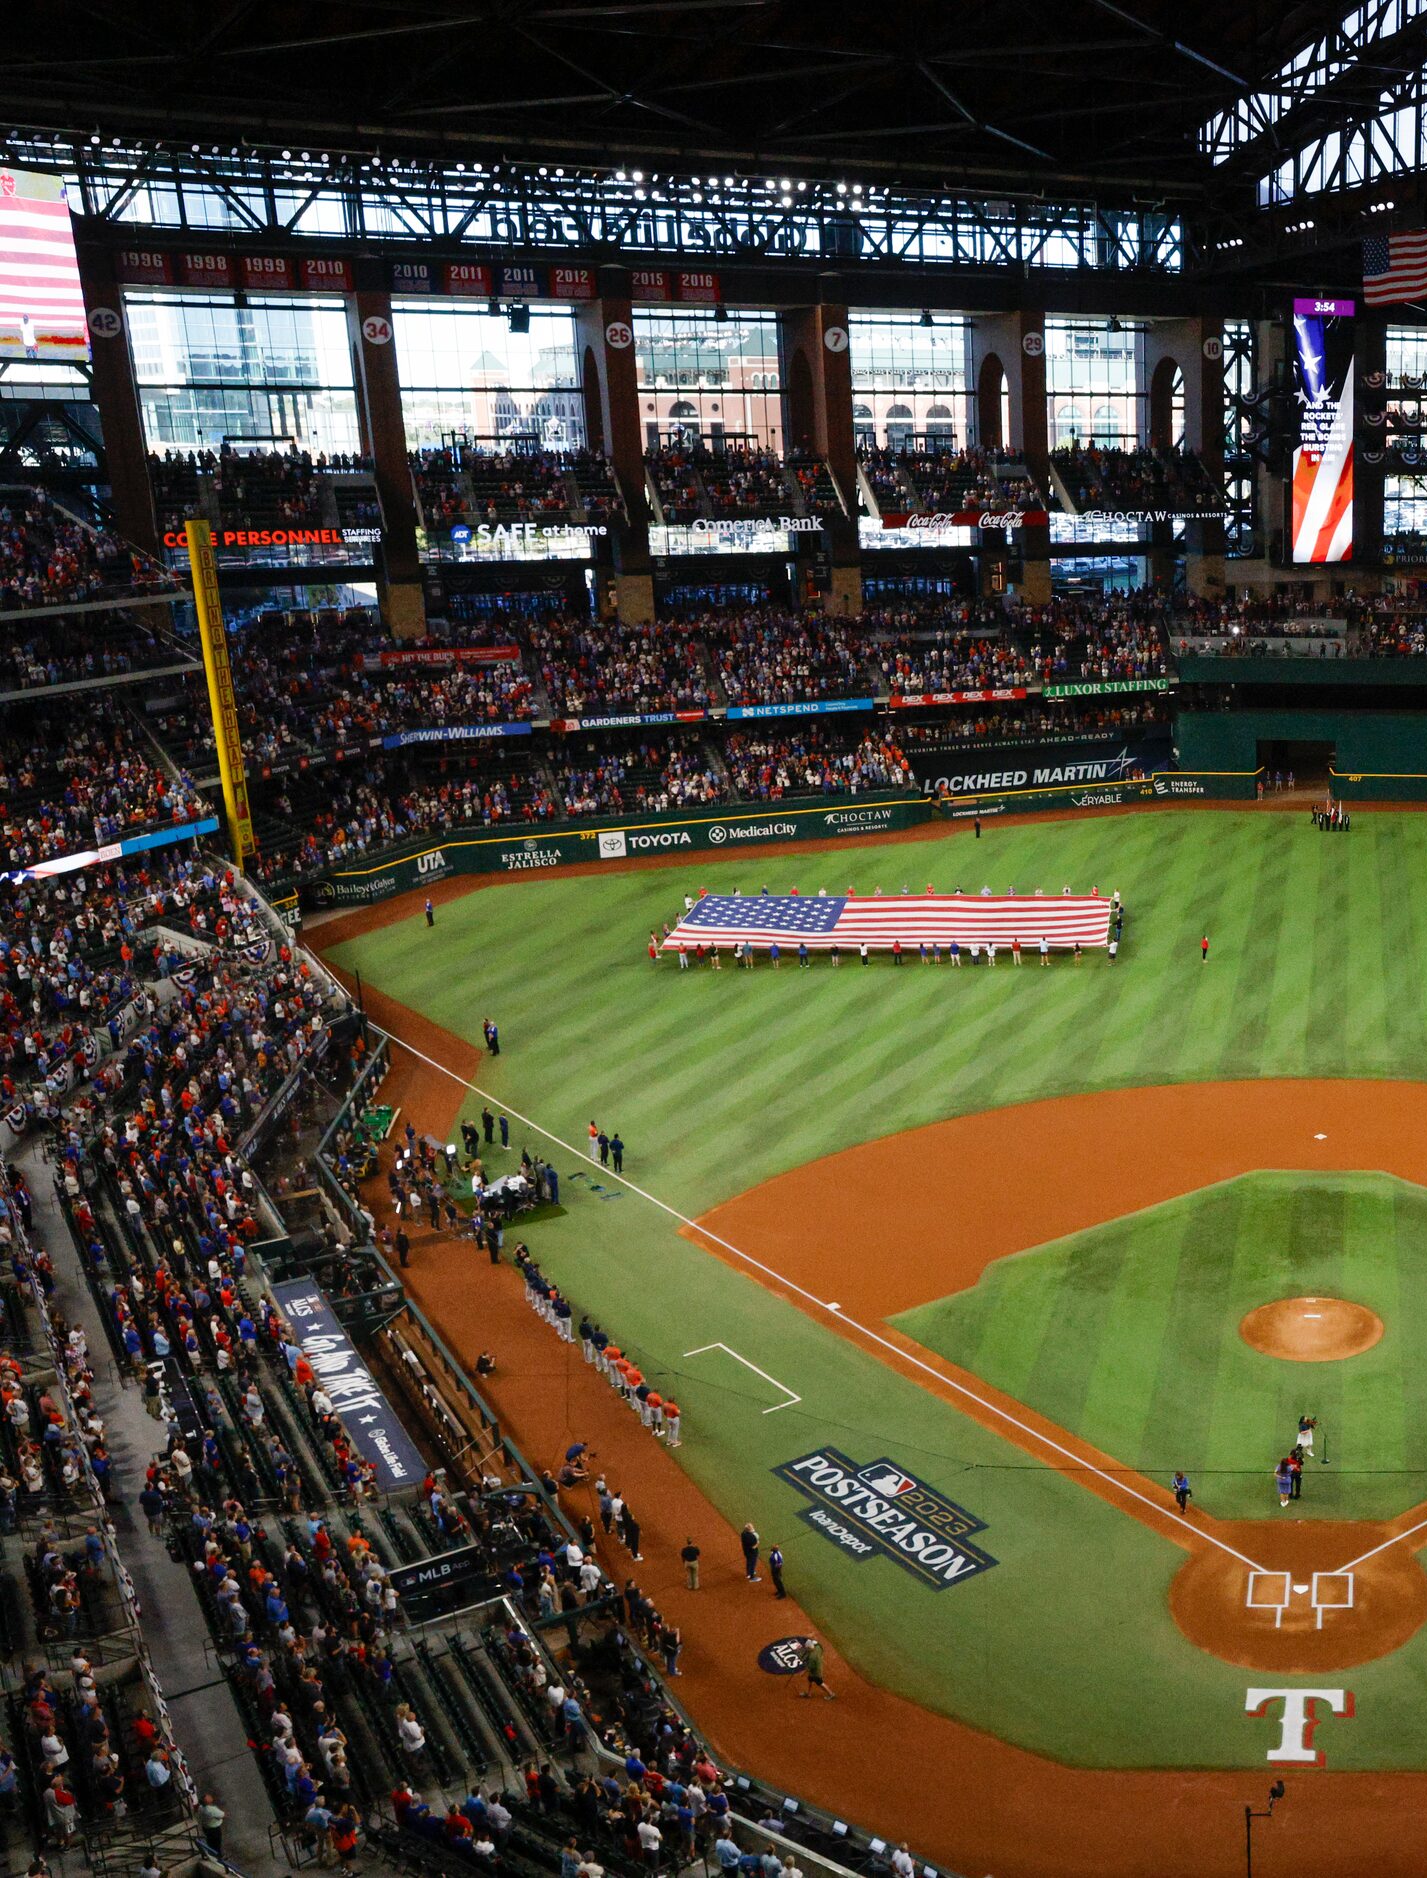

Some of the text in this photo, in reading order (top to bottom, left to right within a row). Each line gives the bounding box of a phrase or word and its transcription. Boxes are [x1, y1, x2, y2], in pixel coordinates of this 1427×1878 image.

[122, 252, 164, 268] 1996
[186, 255, 227, 271] 1998
[245, 256, 286, 273] 1999
[307, 260, 344, 275] 2010
[393, 264, 428, 279] 2010
[450, 265, 482, 280] 2011
[503, 267, 535, 282] 2011
[556, 269, 589, 284] 2012
[632, 271, 663, 286] 2015
[682, 273, 713, 288] 2016
[1314, 302, 1336, 313] 3:54
[91, 313, 116, 332] 42
[366, 321, 389, 339] 34
[609, 327, 630, 343] 26
[832, 331, 841, 347] 7
[1024, 334, 1043, 355] 29
[1206, 340, 1220, 357] 10
[1306, 402, 1342, 410] AND THE
[1301, 422, 1346, 431] RED GLARE
[1300, 433, 1347, 442] THE BOMBS
[1303, 443, 1344, 452] BURSTING
[1311, 454, 1320, 463] IN
[778, 515, 824, 532] Bank
[906, 512, 955, 530] Coca-Cola
[978, 511, 1025, 529] Coca-Cola
[1090, 510, 1167, 523] CHOCTAW
[223, 529, 343, 546] PERSONNEL
[341, 528, 381, 537] STAFFING
[454, 522, 608, 544] ADT SAFE at home
[962, 691, 984, 699] DEX
[992, 689, 1014, 697] DEX
[1056, 679, 1167, 697] LUXOR STAFFING
[902, 695, 924, 703] DEX
[932, 693, 955, 701] DEX
[757, 704, 819, 716] NETSPEND
[581, 714, 642, 728] GARDENERS
[643, 713, 674, 723] TRUST
[924, 763, 1107, 794] LOCKHEED MARTIN
[1170, 780, 1198, 788] ENERGY
[1140, 788, 1153, 796] 410
[833, 809, 891, 824] CHOCTAW
[953, 810, 978, 818] LOCKHEED
[729, 822, 798, 839] Medical City
[865, 824, 889, 832] RESORTS
[579, 832, 597, 841] 372
[629, 831, 692, 849] TOYOTA
[417, 851, 446, 873] UTA
[502, 850, 562, 863] ESTRELLA
[507, 856, 558, 870] JALISCO
[293, 1298, 315, 1317] ALCS
[792, 1456, 976, 1580] POSTSEASON
[901, 1491, 968, 1536] 2023
[809, 1510, 873, 1554] loanDepot
[418, 1559, 470, 1583] MLB App
[773, 1644, 803, 1669] ALCS
[1244, 1688, 1355, 1768] T
